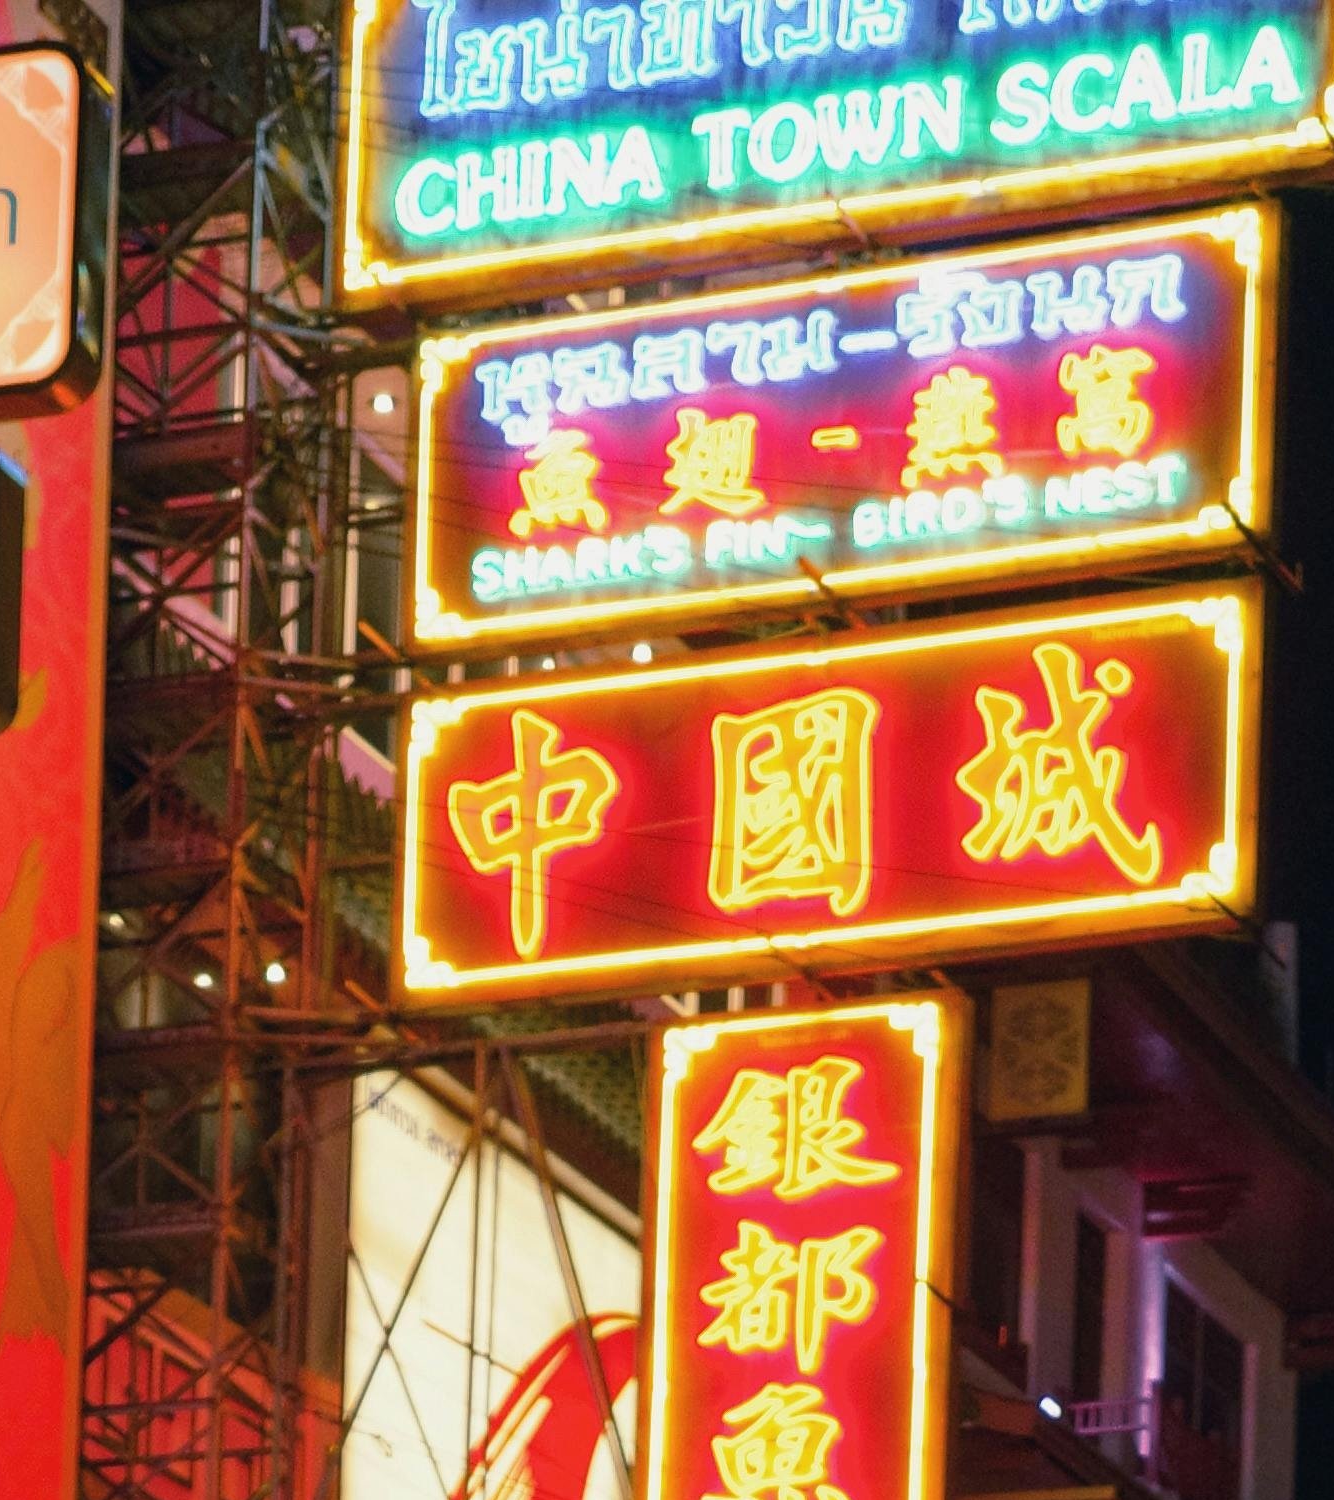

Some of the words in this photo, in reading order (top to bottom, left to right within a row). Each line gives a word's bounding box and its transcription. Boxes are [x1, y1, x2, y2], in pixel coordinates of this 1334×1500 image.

[394, 126, 665, 234] CHINA
[693, 74, 966, 191] TOWN
[991, 26, 1304, 144] SCALA
[472, 524, 691, 602] SHARK'S
[852, 473, 1032, 548] BIRD'S
[1044, 453, 1186, 520] NEST
[448, 642, 1162, 960] 中國城
